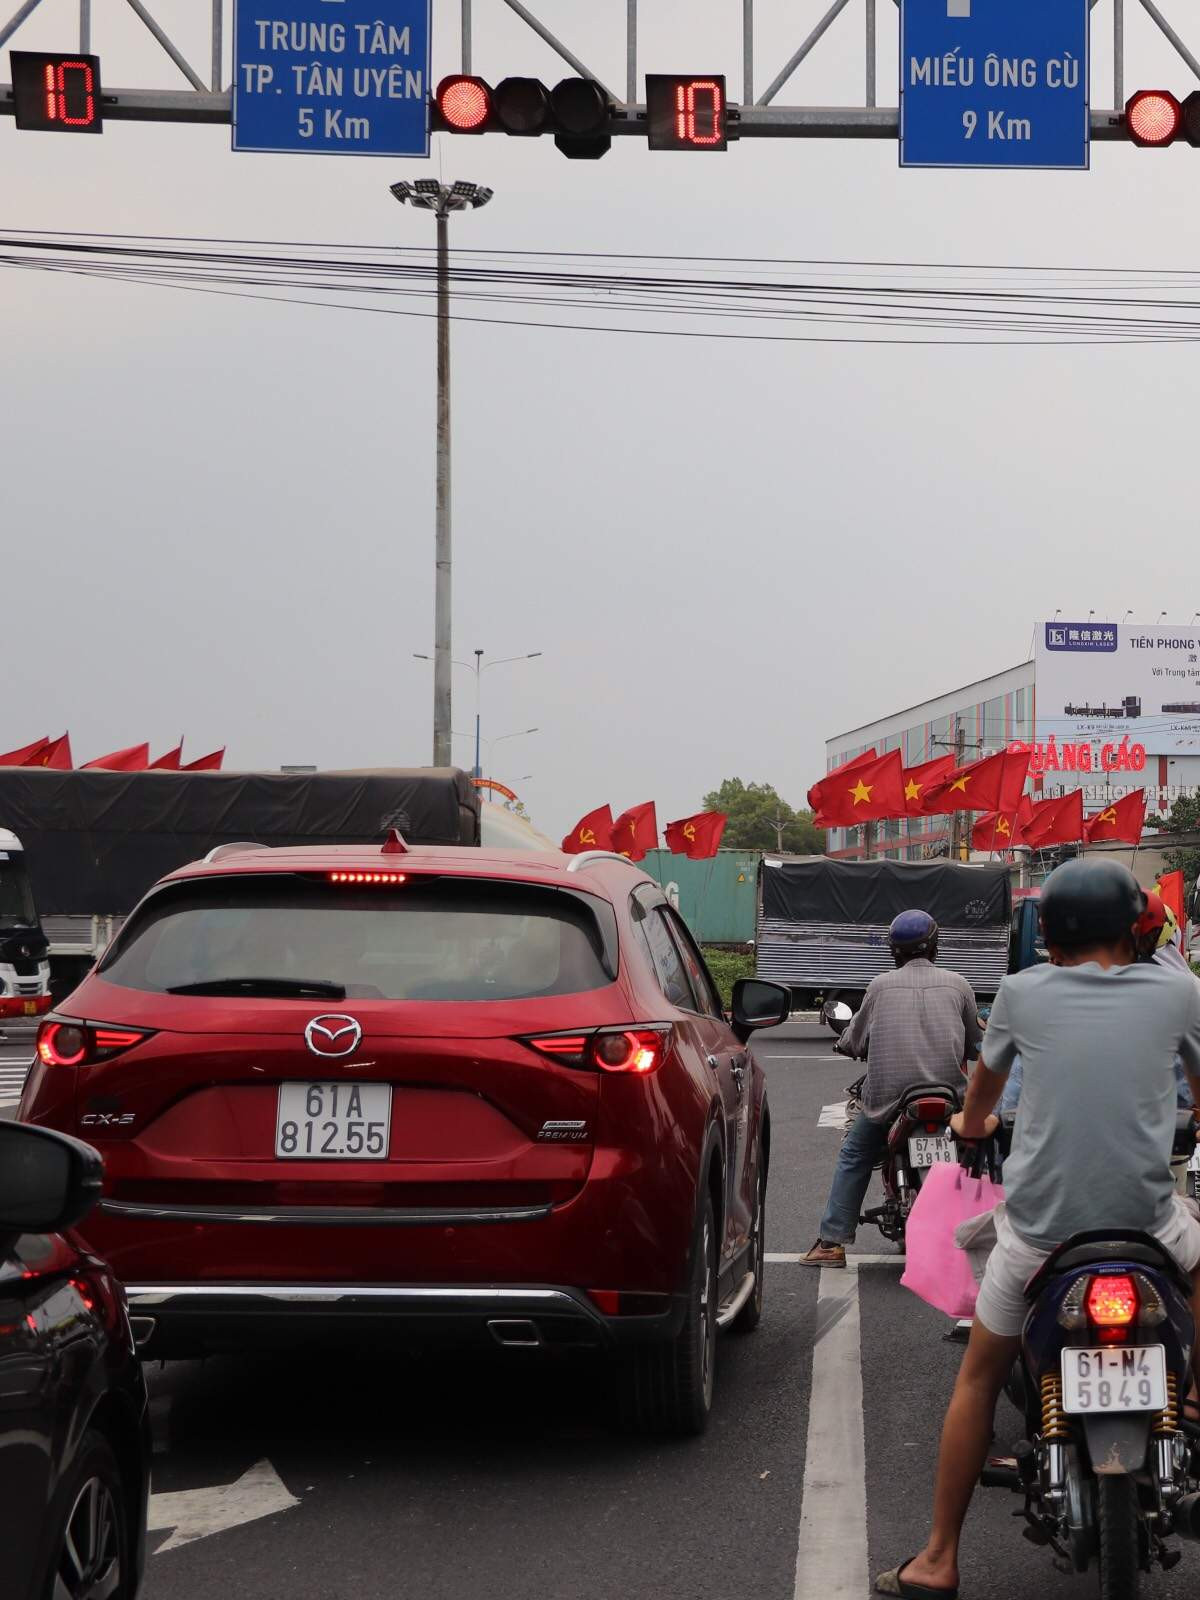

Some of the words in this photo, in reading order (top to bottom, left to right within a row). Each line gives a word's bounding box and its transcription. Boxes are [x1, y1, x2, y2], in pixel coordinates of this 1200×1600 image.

[255, 20, 345, 53] TRUNG
[355, 20, 410, 55] TÂM
[241, 63, 282, 94] TP.
[292, 61, 343, 96] TÂN
[354, 64, 422, 99] UYÊN
[911, 46, 974, 86] MIẾU
[984, 53, 1036, 88] ÔNG
[1046, 51, 1079, 88] CÙ
[46, 62, 93, 126] 10
[298, 108, 314, 138] 5
[324, 109, 369, 139] Km
[677, 82, 721, 145] 10
[962, 110, 977, 139] 9
[987, 110, 1031, 140] Km
[1130, 636, 1154, 649] TIÊN
[1157, 639, 1195, 650] PHONG
[1165, 667, 1186, 678] Trung
[1101, 735, 1147, 772] CÁO
[306, 1085, 362, 1118] 61A
[81, 1113, 135, 1125] CX-5
[280, 1120, 385, 1154] 812.55
[537, 1131, 588, 1139] PREMIUM
[917, 1151, 951, 1165] 3818
[1077, 1350, 1150, 1378] 61-N4
[1077, 1379, 1152, 1408] 5849
